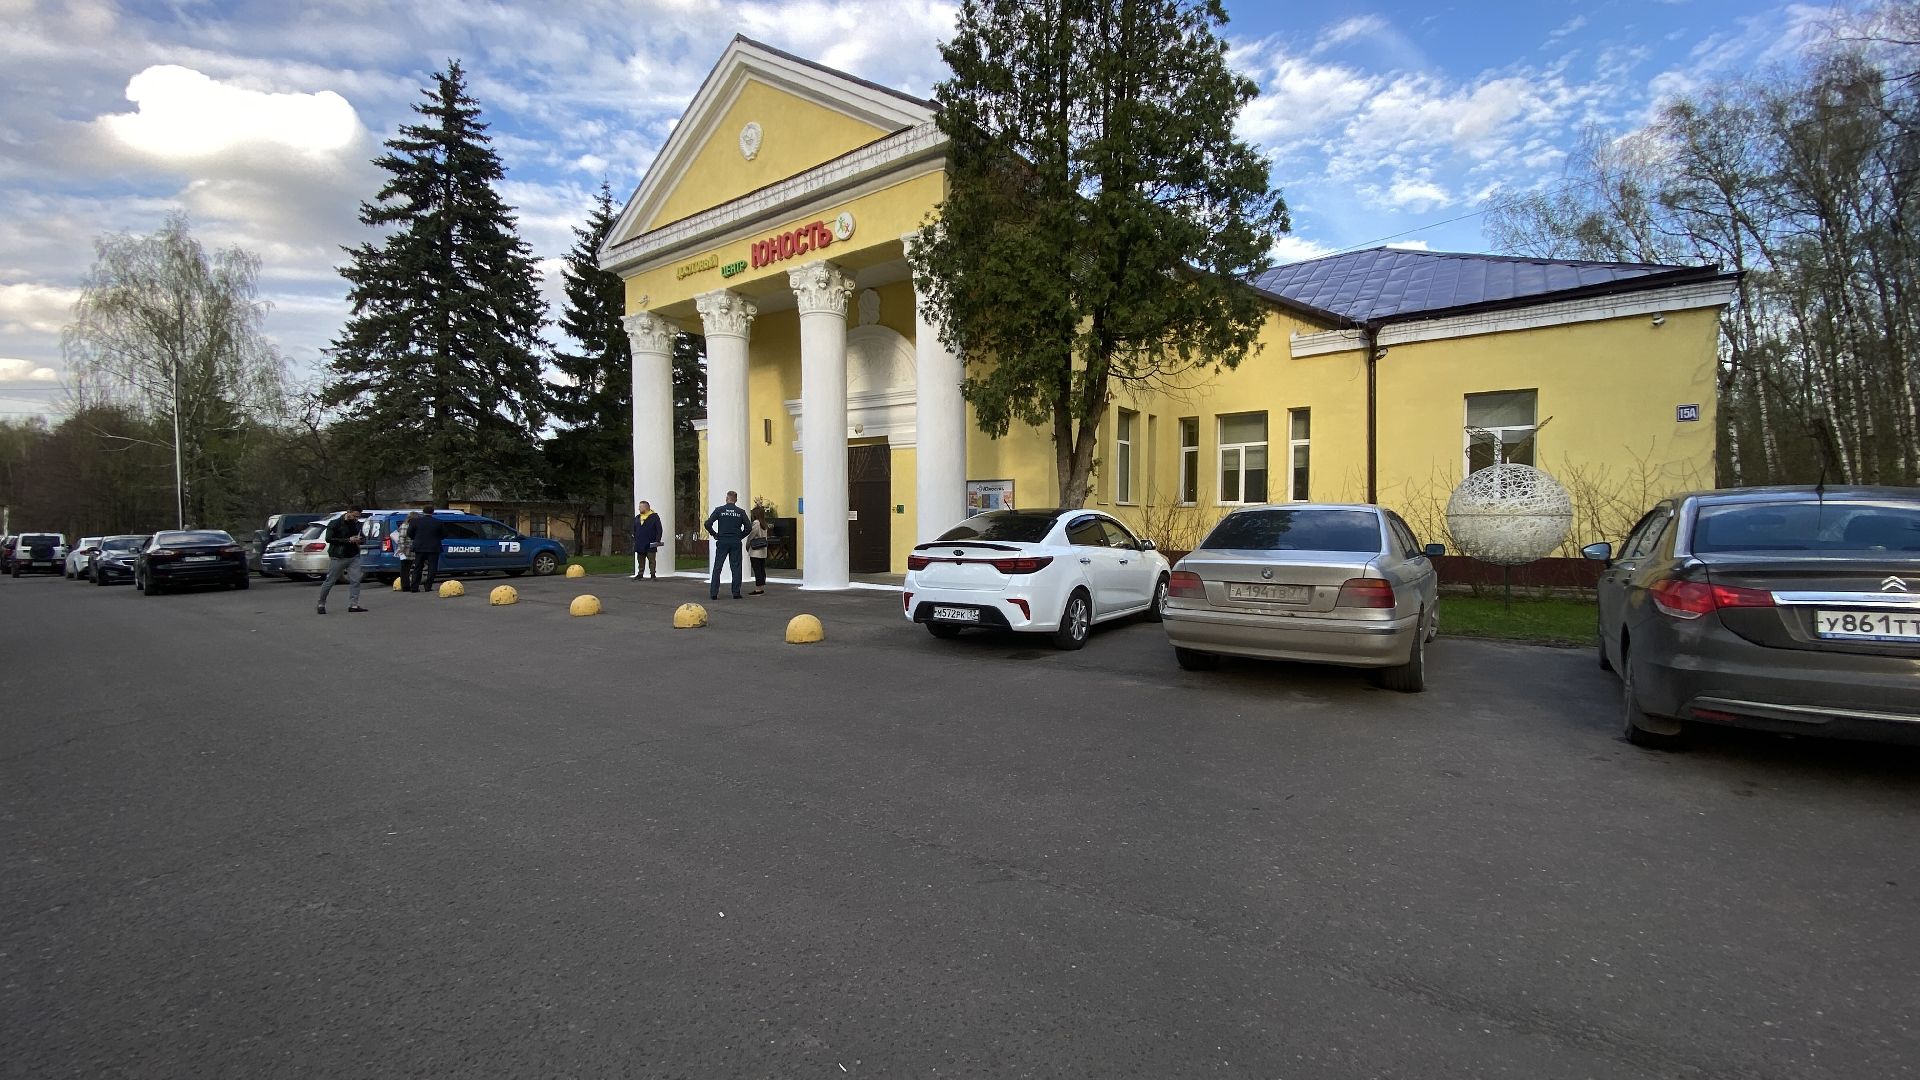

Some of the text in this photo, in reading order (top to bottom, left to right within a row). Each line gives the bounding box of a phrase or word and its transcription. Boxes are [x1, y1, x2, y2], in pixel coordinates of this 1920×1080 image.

[721, 260, 748, 279] ЦЕНТР
[751, 220, 834, 270] ЮНОСТЬ
[1680, 407, 1697, 419] 15А
[498, 541, 521, 553] ТВ
